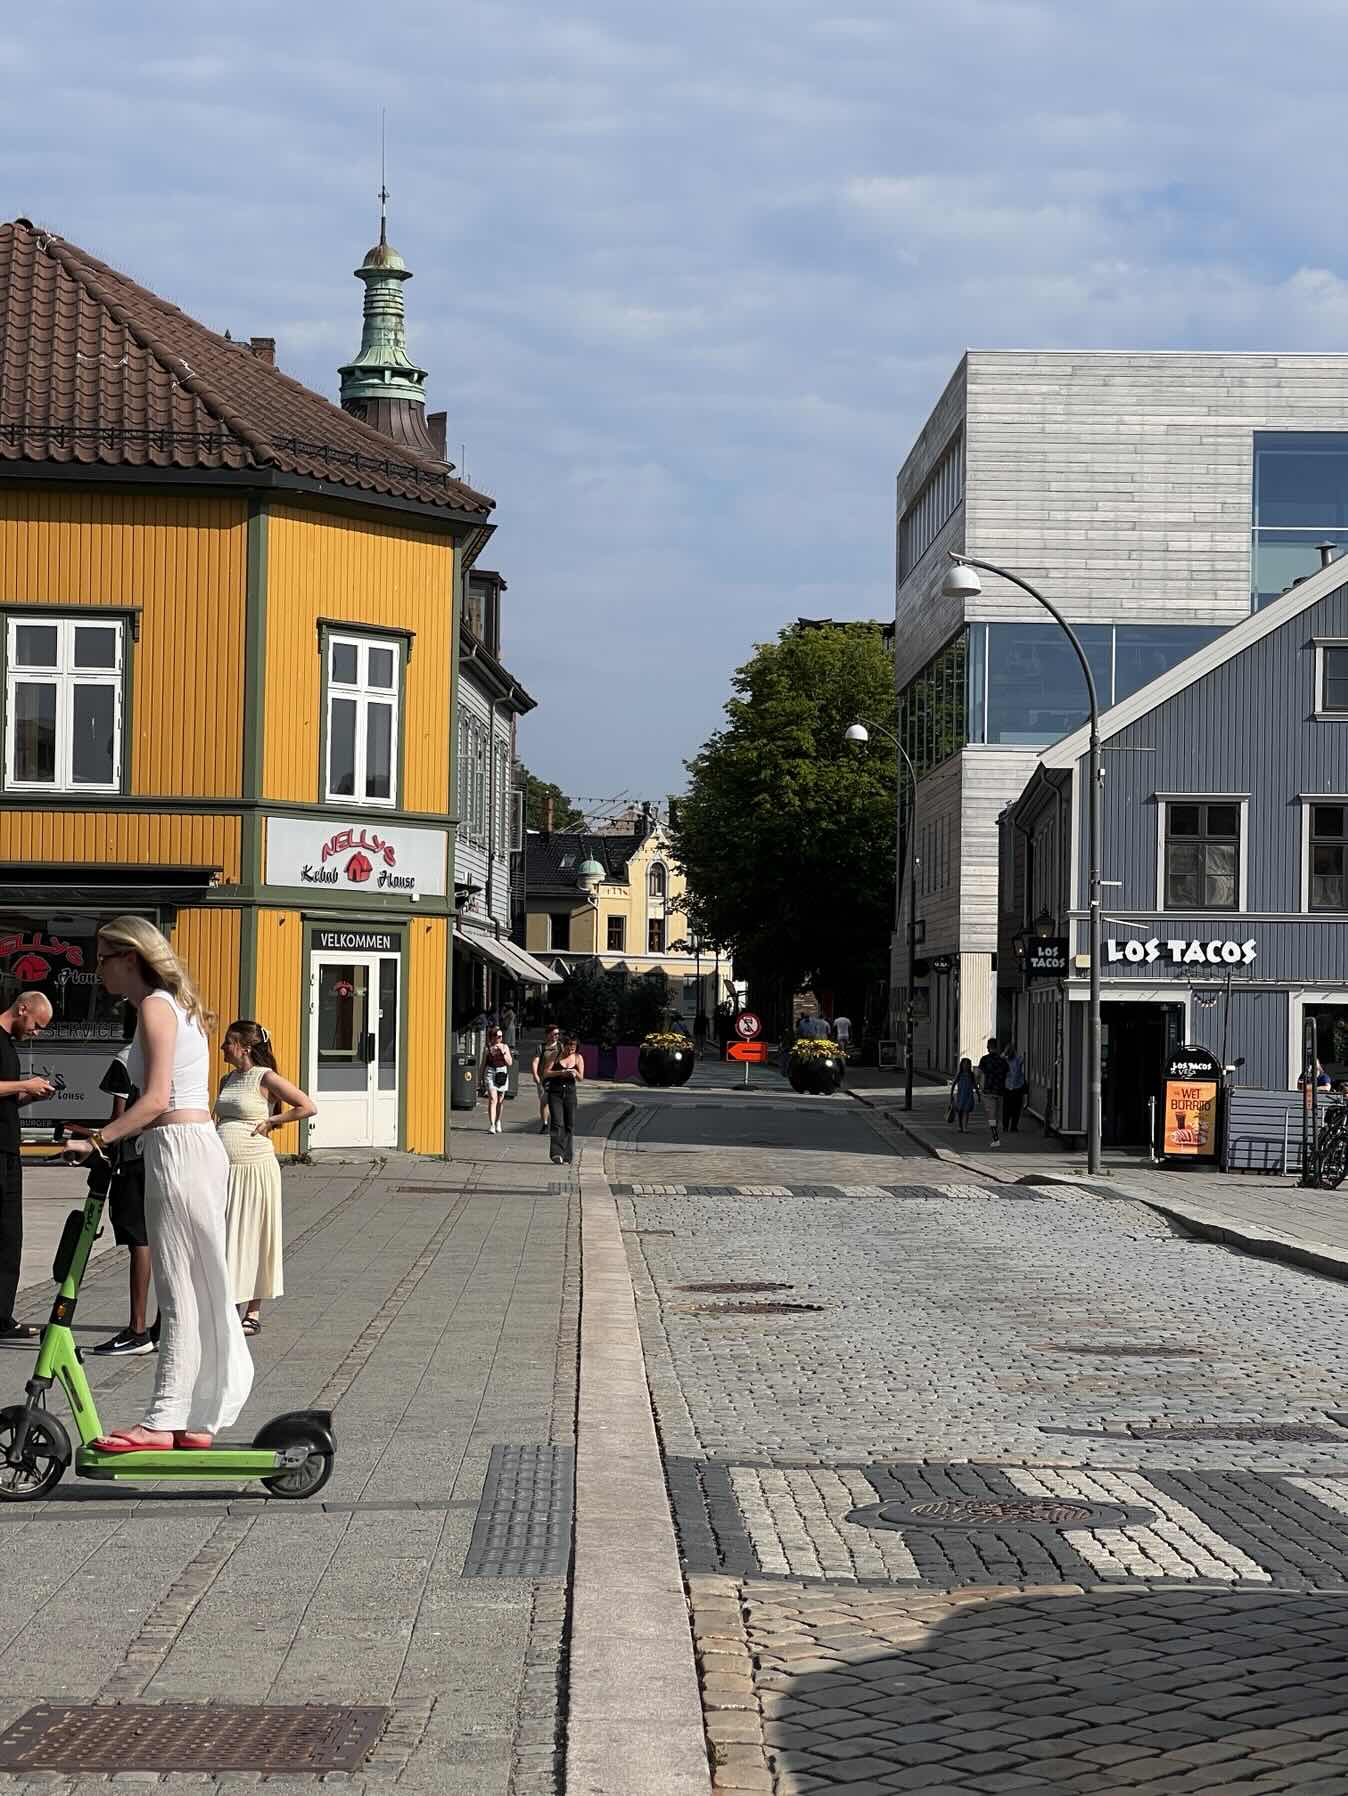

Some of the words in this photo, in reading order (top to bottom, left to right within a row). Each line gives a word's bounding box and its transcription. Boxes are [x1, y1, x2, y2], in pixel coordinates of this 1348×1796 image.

[301, 864, 339, 884] Kebab
[377, 870, 416, 889] House
[321, 933, 391, 949] VELKOMMEN
[1037, 946, 1059, 956] LOS
[1107, 938, 1160, 963] LOS
[1167, 938, 1257, 964] TACOS
[1030, 957, 1065, 968] TACOS
[55, 968, 104, 985] Hous
[47, 1023, 122, 1038] SERVICE
[1172, 1061, 1188, 1070] LOS
[1188, 1062, 1212, 1071] TACOS
[1181, 1088, 1200, 1099] WET
[1170, 1099, 1211, 1111] BURRITO
